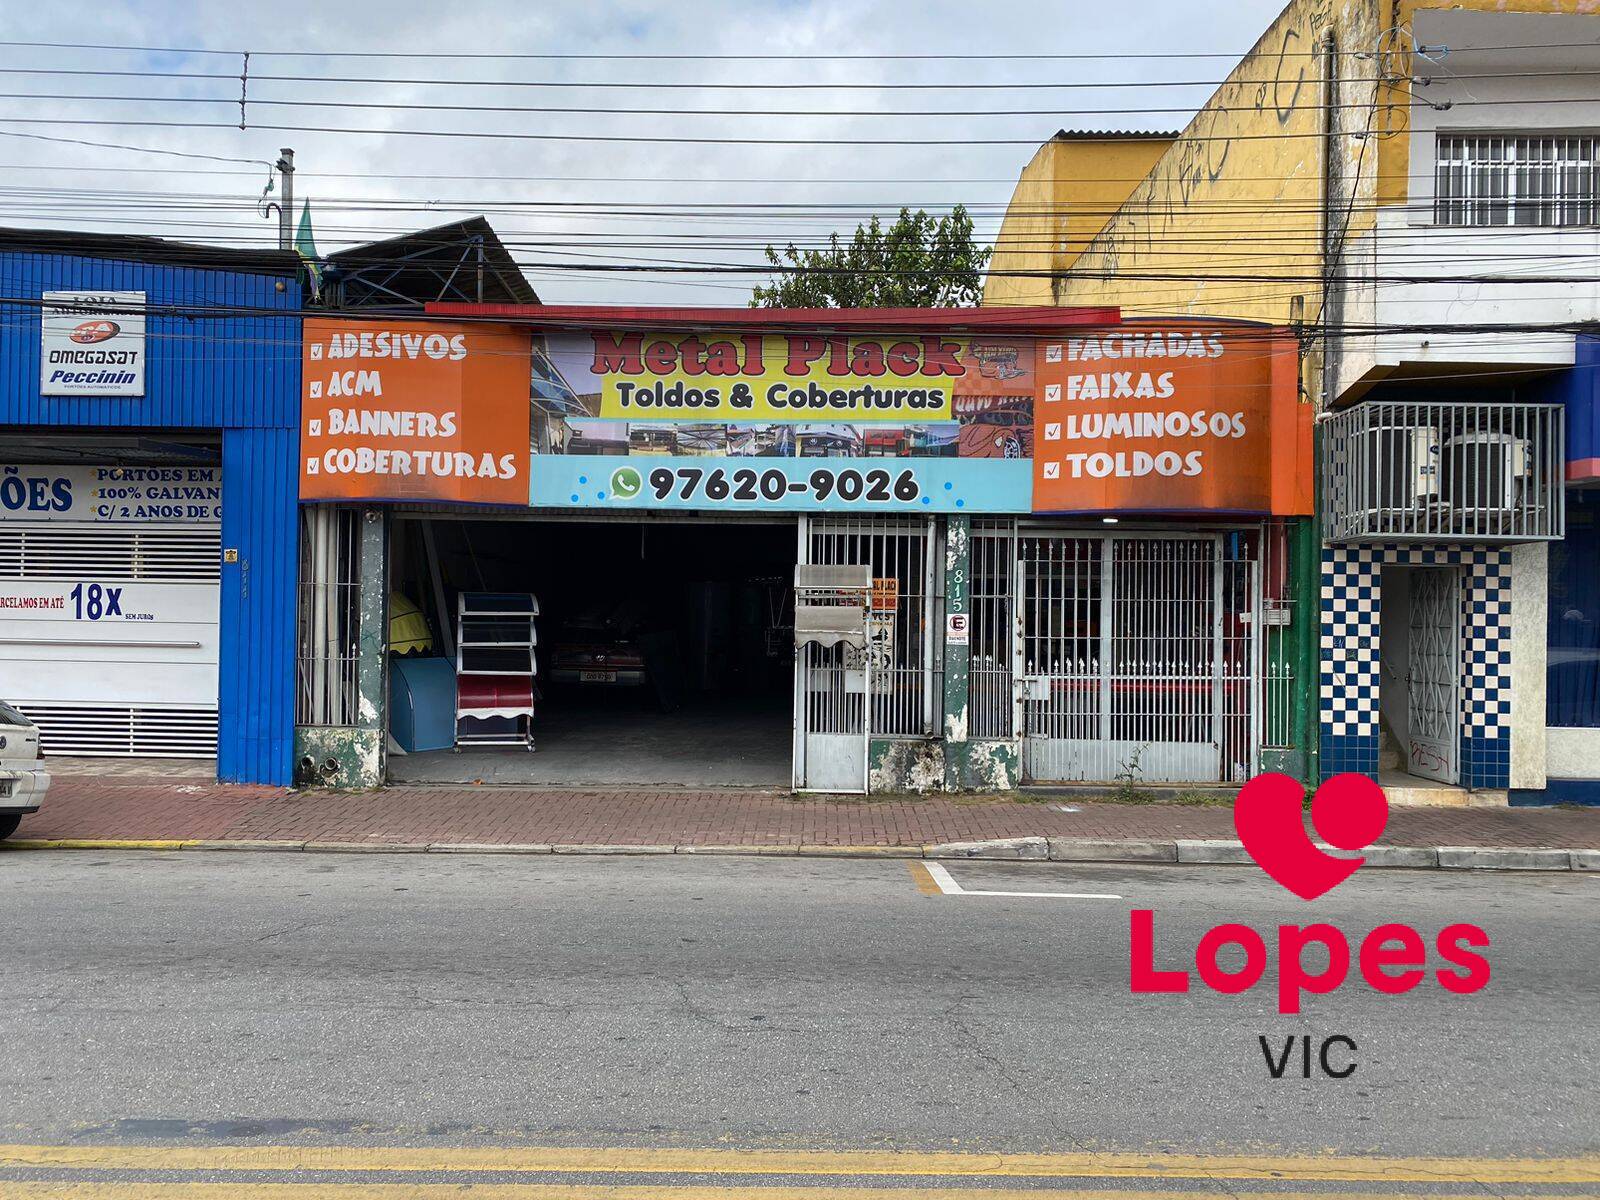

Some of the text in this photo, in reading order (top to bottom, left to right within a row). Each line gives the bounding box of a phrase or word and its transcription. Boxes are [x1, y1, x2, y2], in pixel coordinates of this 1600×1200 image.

[328, 332, 467, 360] ADESIVOS
[590, 331, 966, 376] Metal Plack
[1067, 332, 1224, 361] FACHADAS
[49, 370, 136, 384] Peccinin
[327, 371, 382, 397] ACM
[1067, 372, 1175, 400] FAIXAS
[616, 381, 720, 408] Toldos
[729, 383, 753, 408] &
[767, 382, 944, 408] Coberturas
[328, 409, 457, 437] BANNERS
[1067, 411, 1246, 439] LUMINOSOS
[187, 469, 214, 481] EM
[323, 448, 517, 479] COBERTURAS
[1066, 451, 1203, 478] TOLDOS
[98, 487, 141, 499] 100%
[649, 469, 918, 500] 97620-9026
[97, 505, 116, 519] C/
[120, 507, 130, 517] 2
[134, 505, 183, 517] ANOS
[187, 506, 210, 517] DE
[39, 599, 49, 608] EM
[952, 569, 964, 612] 815
